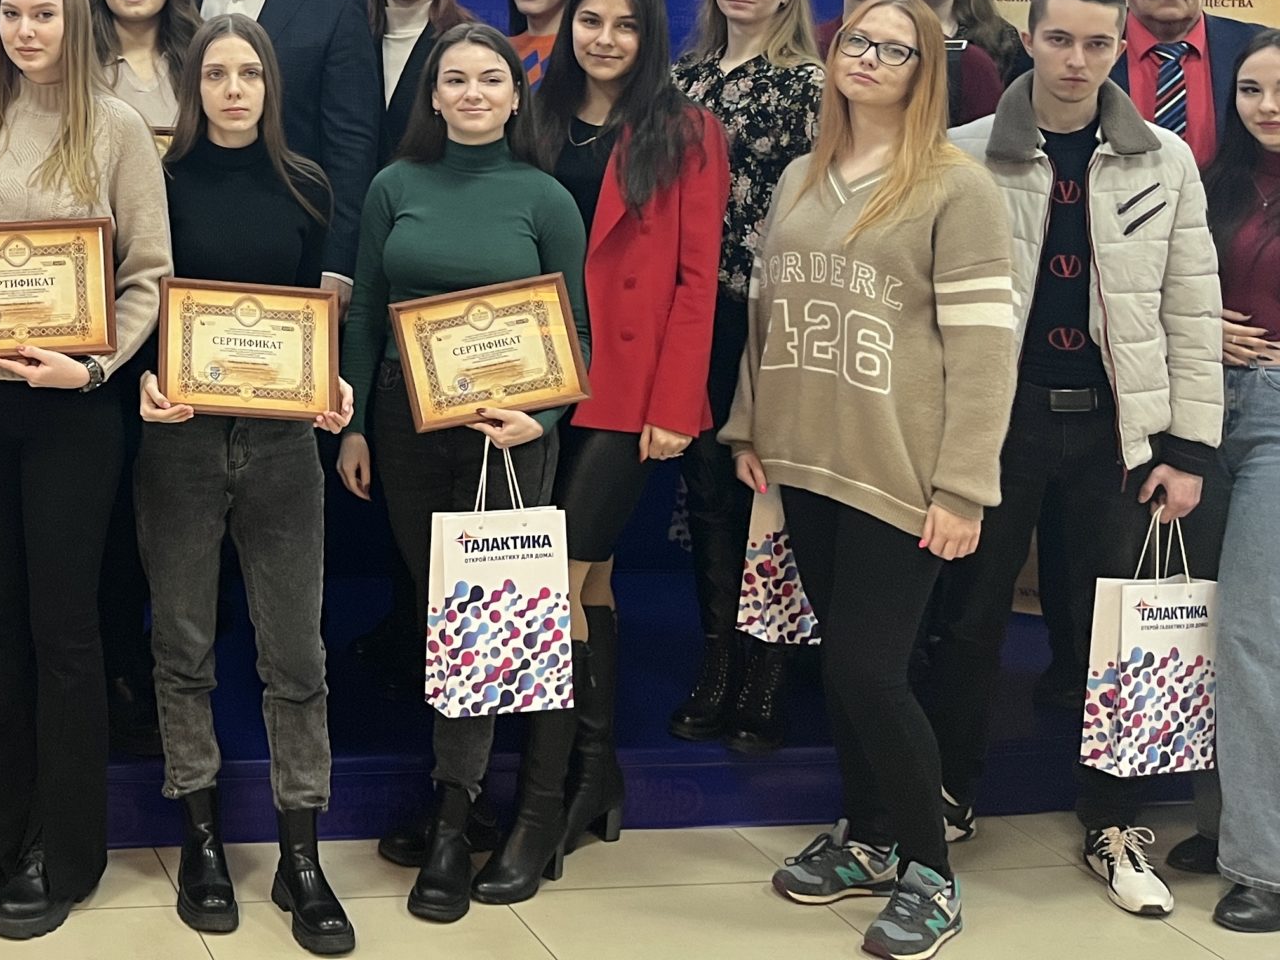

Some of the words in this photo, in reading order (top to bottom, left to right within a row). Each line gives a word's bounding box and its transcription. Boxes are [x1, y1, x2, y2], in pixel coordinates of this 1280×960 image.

[212, 336, 284, 350] СЕРТИФИКАТ
[452, 336, 522, 357] СЕРТИФИКАТ
[463, 534, 553, 554] ГАЛАКТИКА
[464, 556, 487, 565] ОТКРОЙ
[487, 553, 520, 563] ГАЛАКТИКУ
[520, 552, 534, 560] ДЛЯ
[1140, 604, 1209, 622] ГАЛАКТИКА
